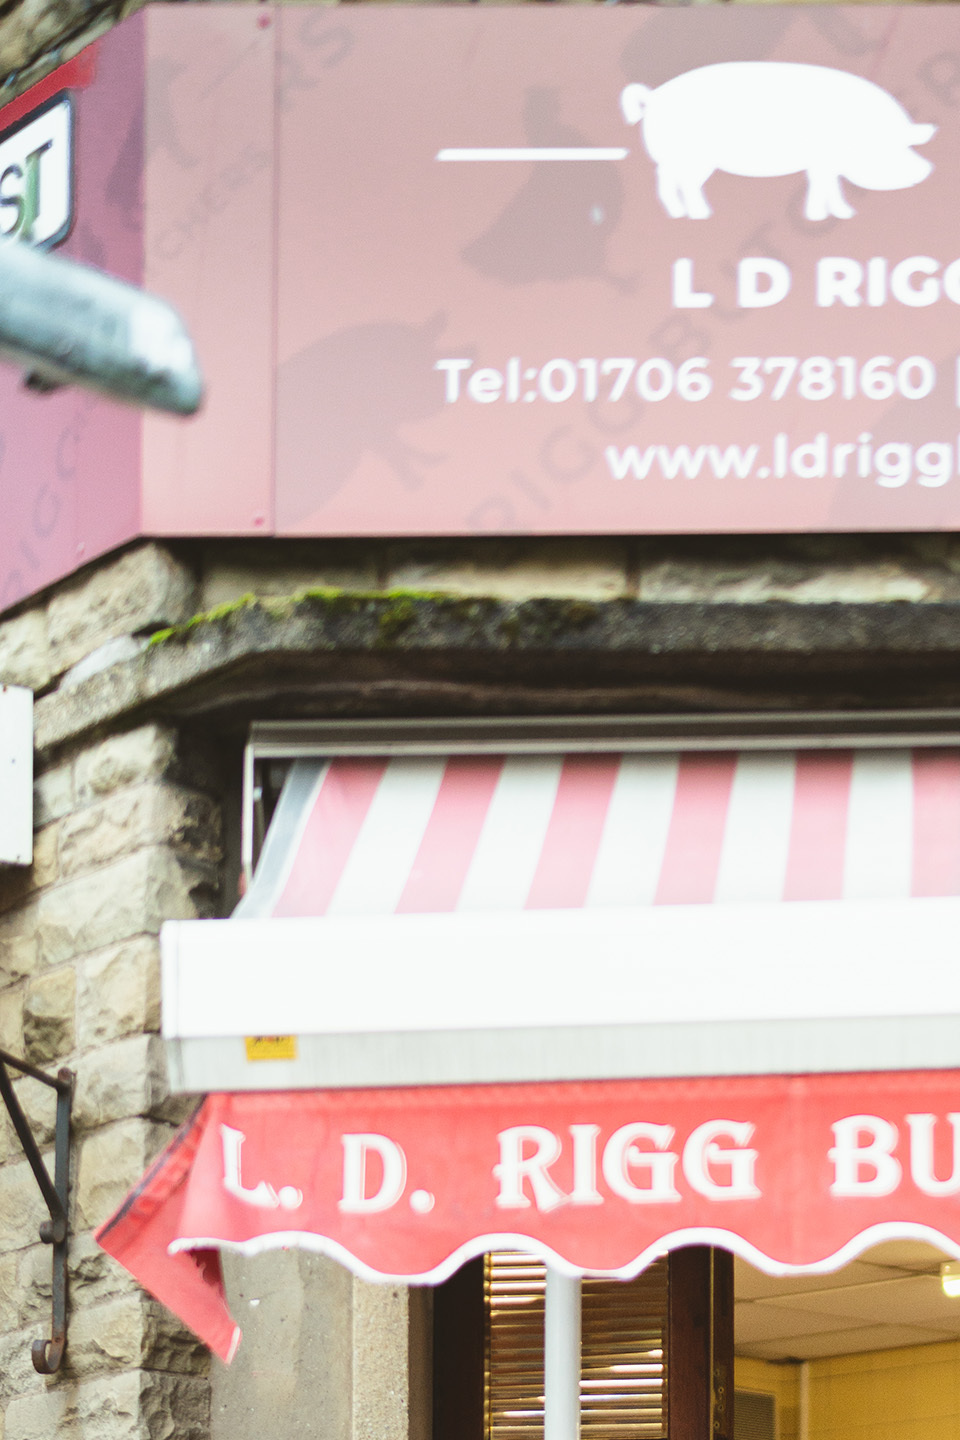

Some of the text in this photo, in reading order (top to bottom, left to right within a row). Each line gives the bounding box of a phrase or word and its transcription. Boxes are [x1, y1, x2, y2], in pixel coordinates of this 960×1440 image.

[673, 258, 713, 309] L
[738, 257, 791, 308] D
[436, 357, 712, 404] Tel:01706
[730, 355, 935, 402] 378160
[222, 1123, 304, 1210] L.
[338, 1133, 435, 1214] D.
[493, 1120, 761, 1213] RIGG
